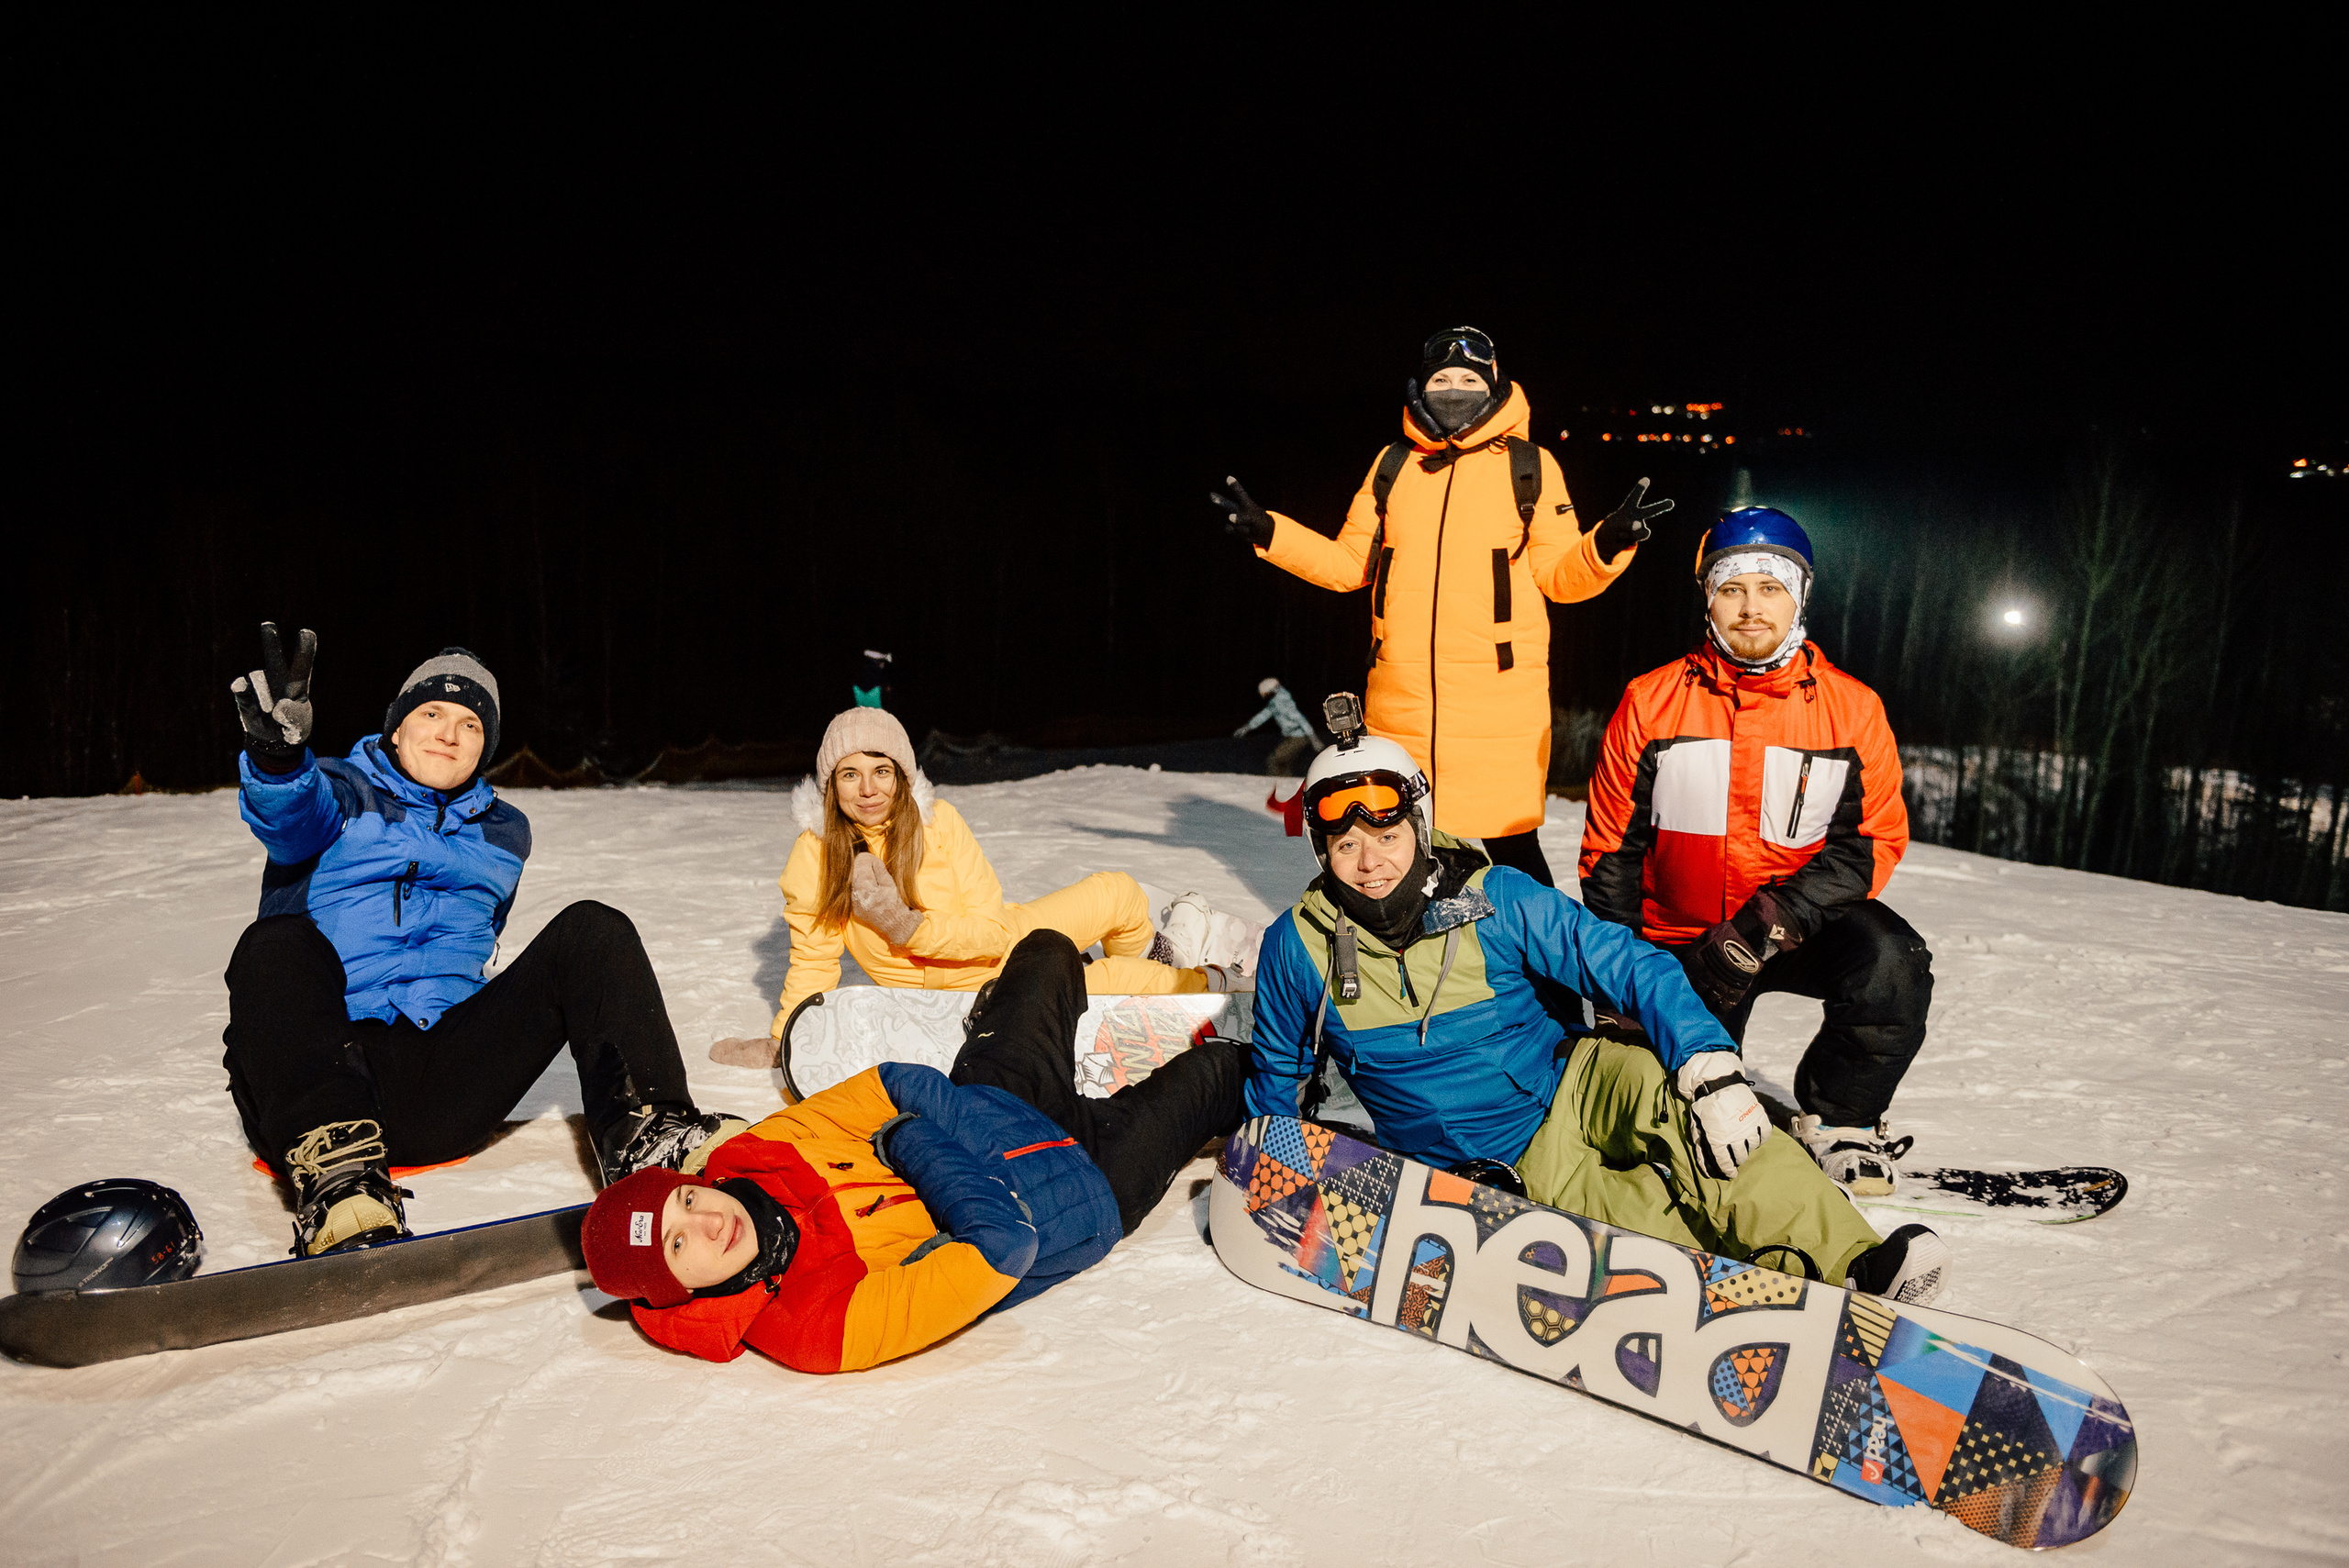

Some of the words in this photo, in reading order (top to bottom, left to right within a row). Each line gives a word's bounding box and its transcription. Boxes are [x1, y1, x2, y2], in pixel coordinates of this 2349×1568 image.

[1103, 1008, 1156, 1087] ANTA
[634, 1215, 644, 1228] Era
[634, 1227, 643, 1243] New
[150, 1240, 176, 1265] 58-61
[1371, 1158, 1844, 1473] head
[1865, 1416, 1896, 1463] head
